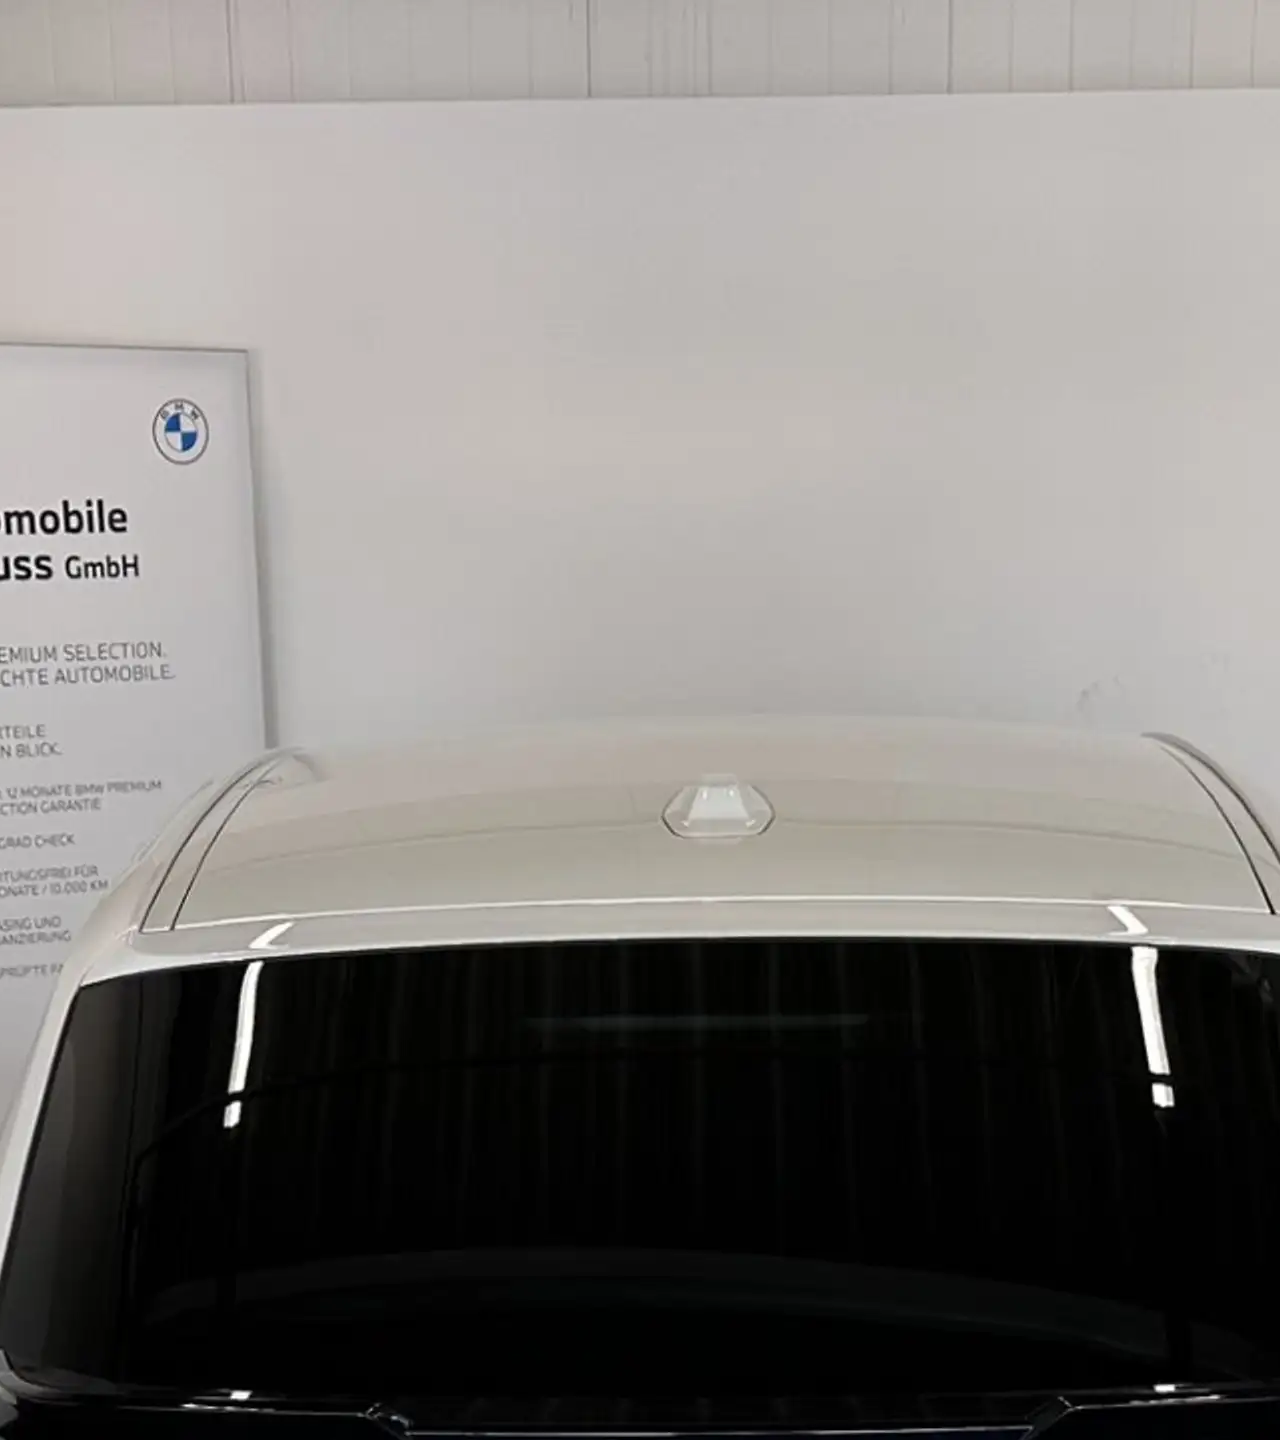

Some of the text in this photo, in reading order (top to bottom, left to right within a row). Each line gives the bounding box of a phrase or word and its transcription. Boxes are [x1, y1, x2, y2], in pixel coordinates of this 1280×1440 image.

[65, 554, 139, 579] GmbH
[63, 641, 167, 662] SELECTION.
[20, 784, 71, 800] MONATE
[75, 783, 104, 796] BMW
[107, 780, 162, 794] PREMIUM
[40, 798, 101, 815] GARANTIE
[35, 832, 75, 847] CHECK
[74, 864, 99, 878] FÜR
[90, 879, 109, 891] KM
